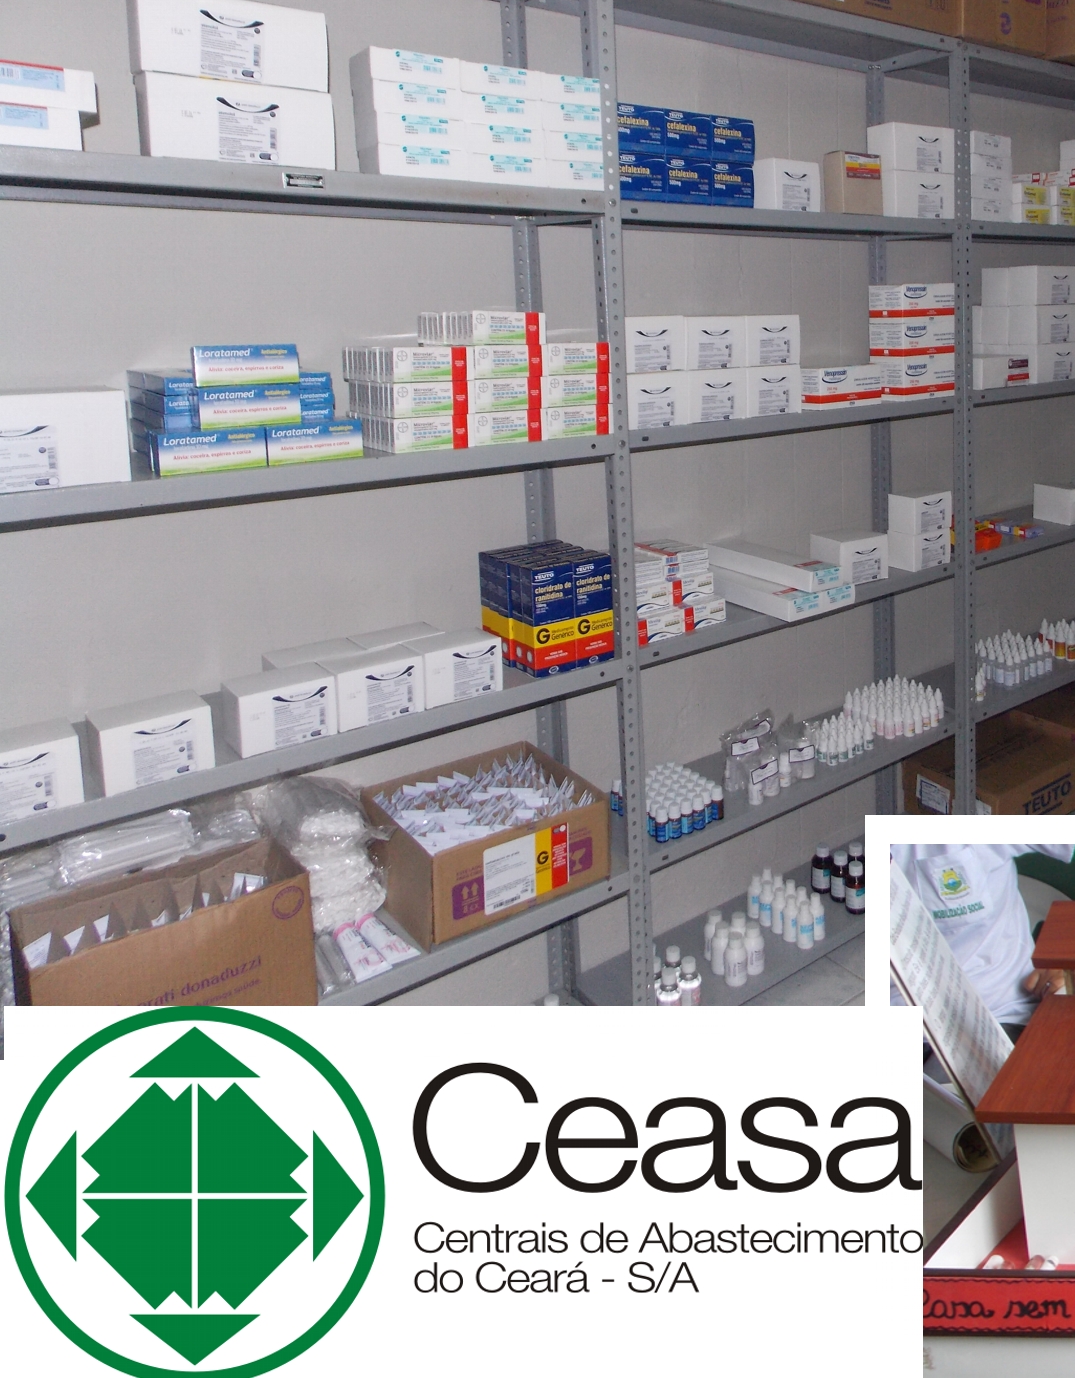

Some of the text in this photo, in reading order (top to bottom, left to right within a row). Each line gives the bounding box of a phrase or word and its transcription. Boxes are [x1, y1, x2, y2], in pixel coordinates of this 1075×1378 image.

[667, 122, 696, 132] cefalexina
[714, 127, 741, 137] cefalexina
[669, 169, 698, 179] cefalexina
[714, 173, 741, 182] cefalexina
[199, 348, 250, 358] Loratamed
[204, 390, 255, 400] Loratamed
[272, 426, 320, 438] Loratamed
[164, 434, 217, 447] Loratamed
[576, 565, 594, 573] TEUTO
[535, 572, 554, 580] TEUTO
[576, 576, 602, 585] cloridrato
[535, 584, 563, 594] cloridrato
[576, 583, 603, 593] ranitidina
[536, 592, 563, 602] ranitidina
[577, 619, 591, 635] G
[592, 621, 613, 631] Genérico
[536, 628, 550, 644] G
[551, 630, 574, 641] Genérico
[1022, 781, 1071, 815] TEUTO
[932, 901, 984, 919] MOBILIZAÇÃO SOCIAL
[181, 955, 262, 996] donaduzzi
[1003, 1297, 1071, 1320] sem
